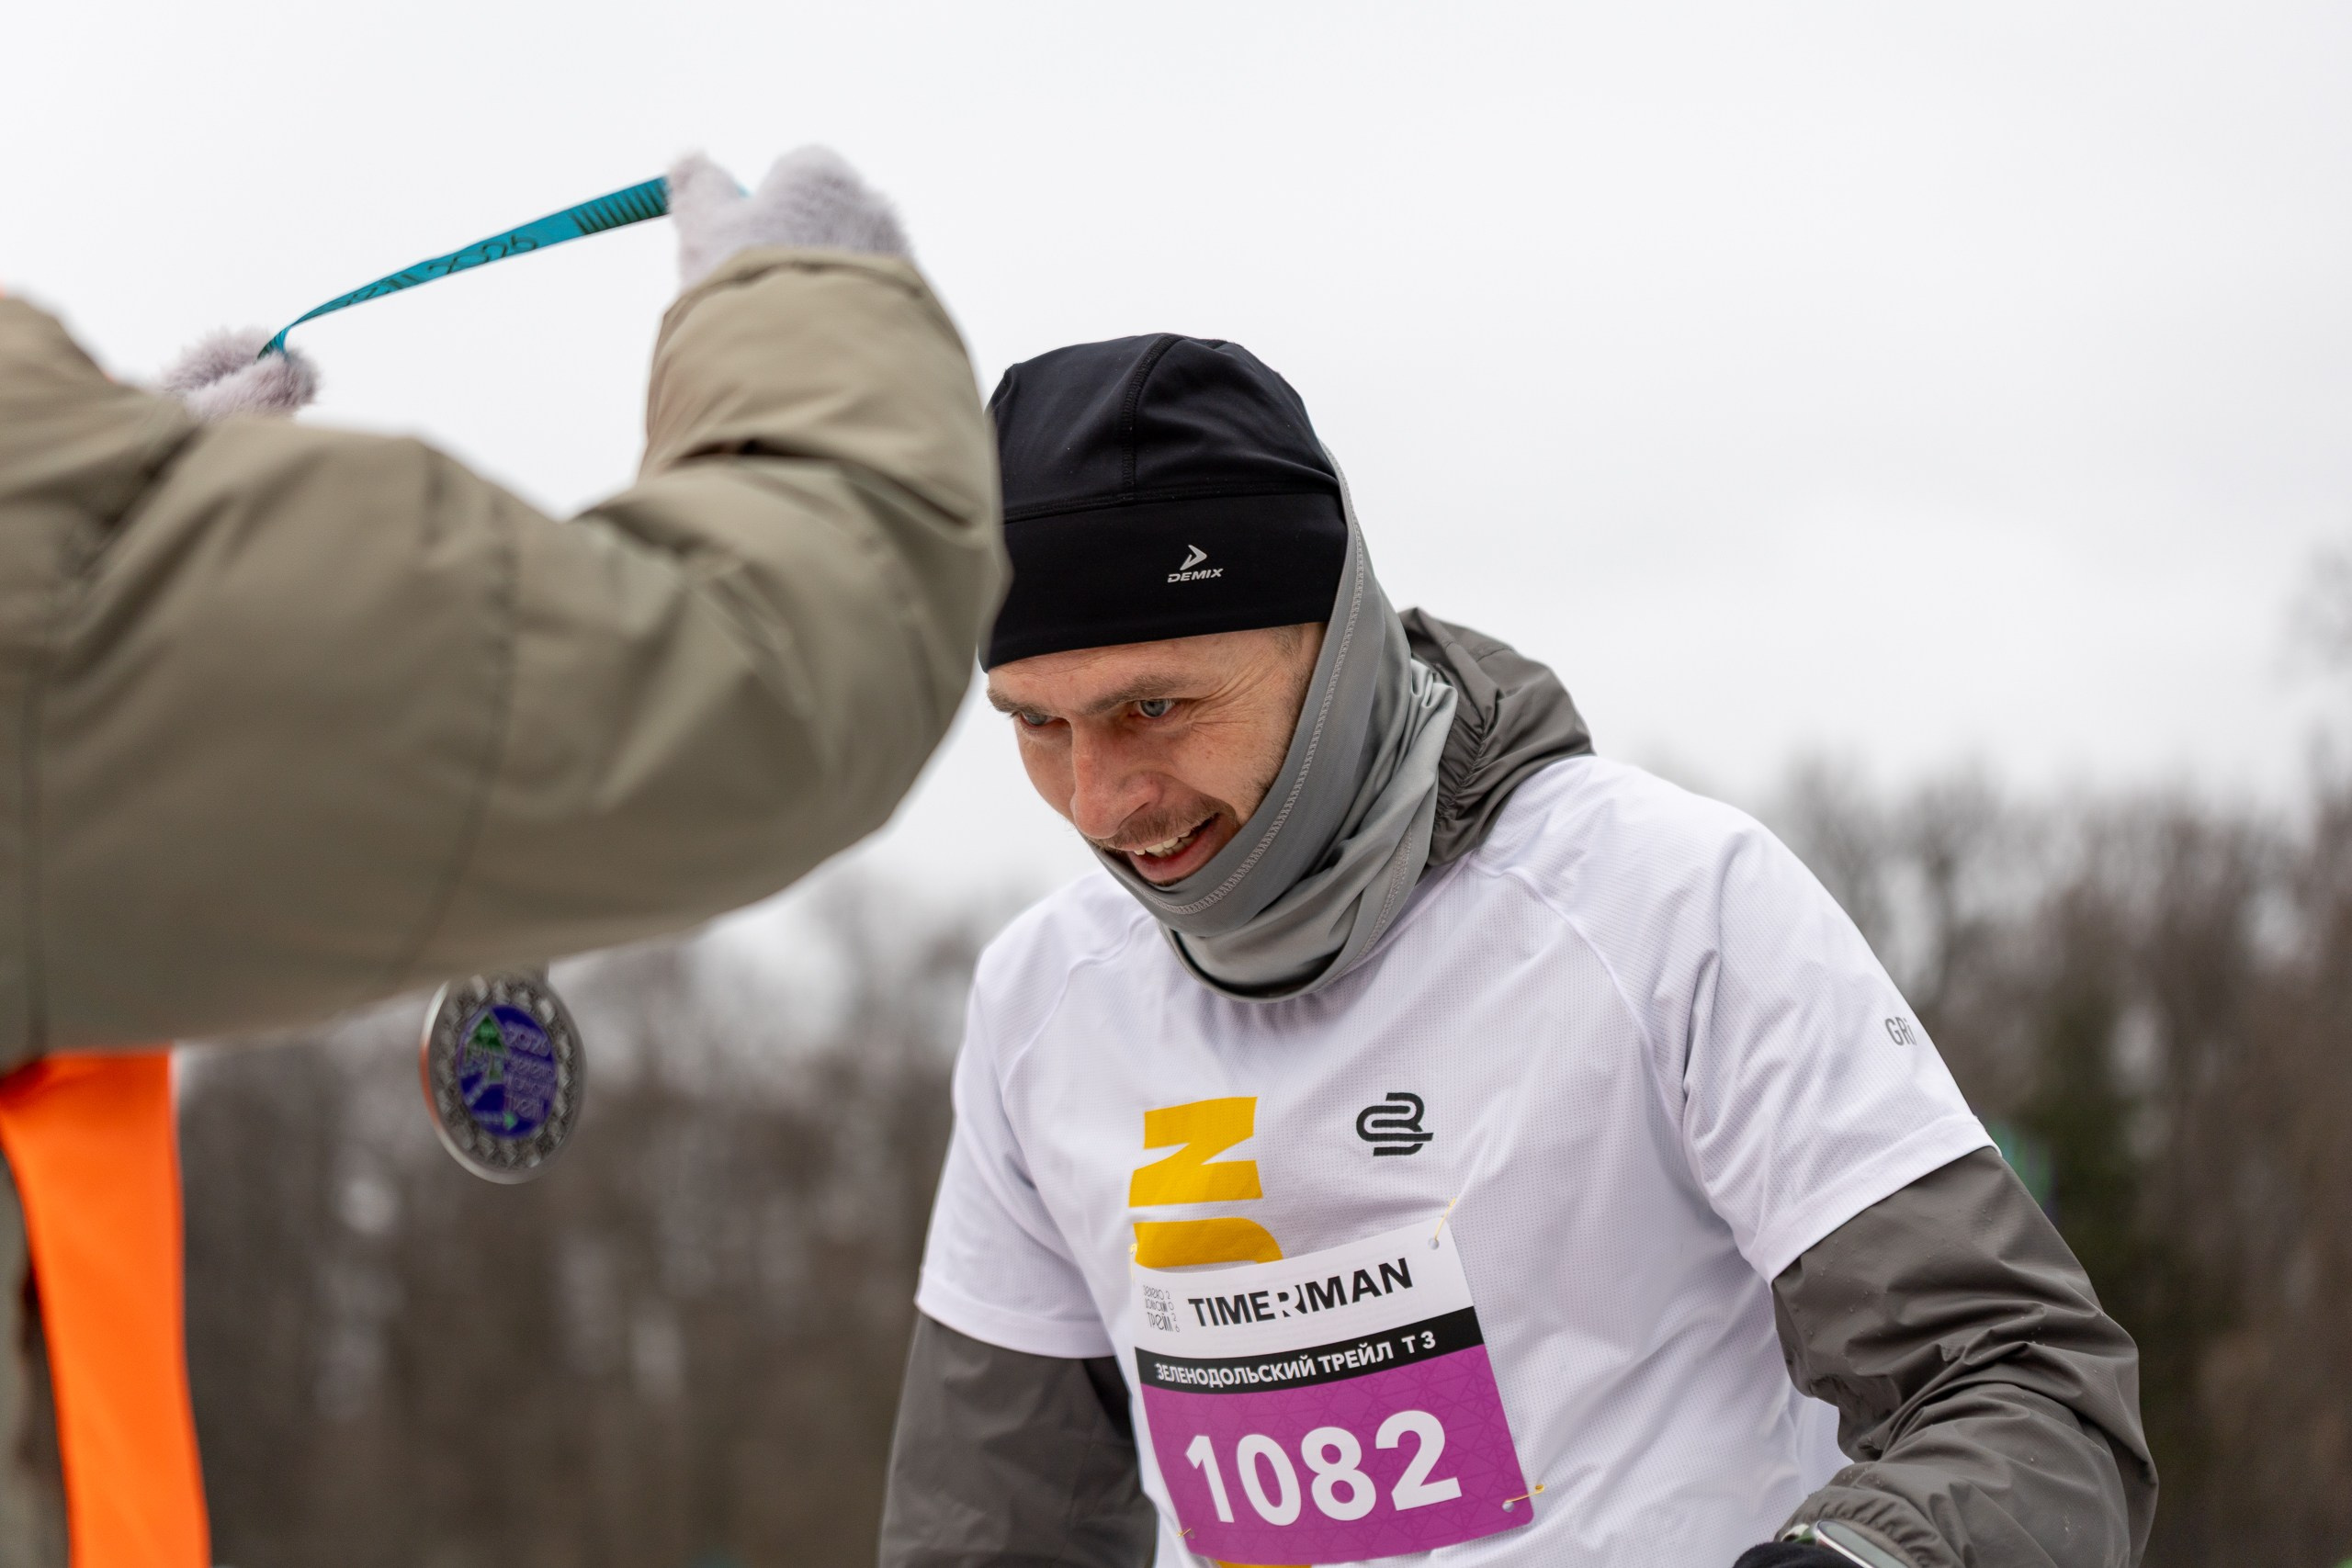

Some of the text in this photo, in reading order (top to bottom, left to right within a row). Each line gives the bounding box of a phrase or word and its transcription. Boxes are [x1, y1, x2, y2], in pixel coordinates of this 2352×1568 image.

[1167, 569, 1224, 583] DEMIX
[1187, 1257, 1414, 1327] TIMERMAN
[1154, 1355, 1317, 1388] ЗЕЛЕНОДОЛЬСКИЙ
[1317, 1341, 1395, 1373] ТРЕЙЛ
[1185, 1409, 1463, 1527] 1082
